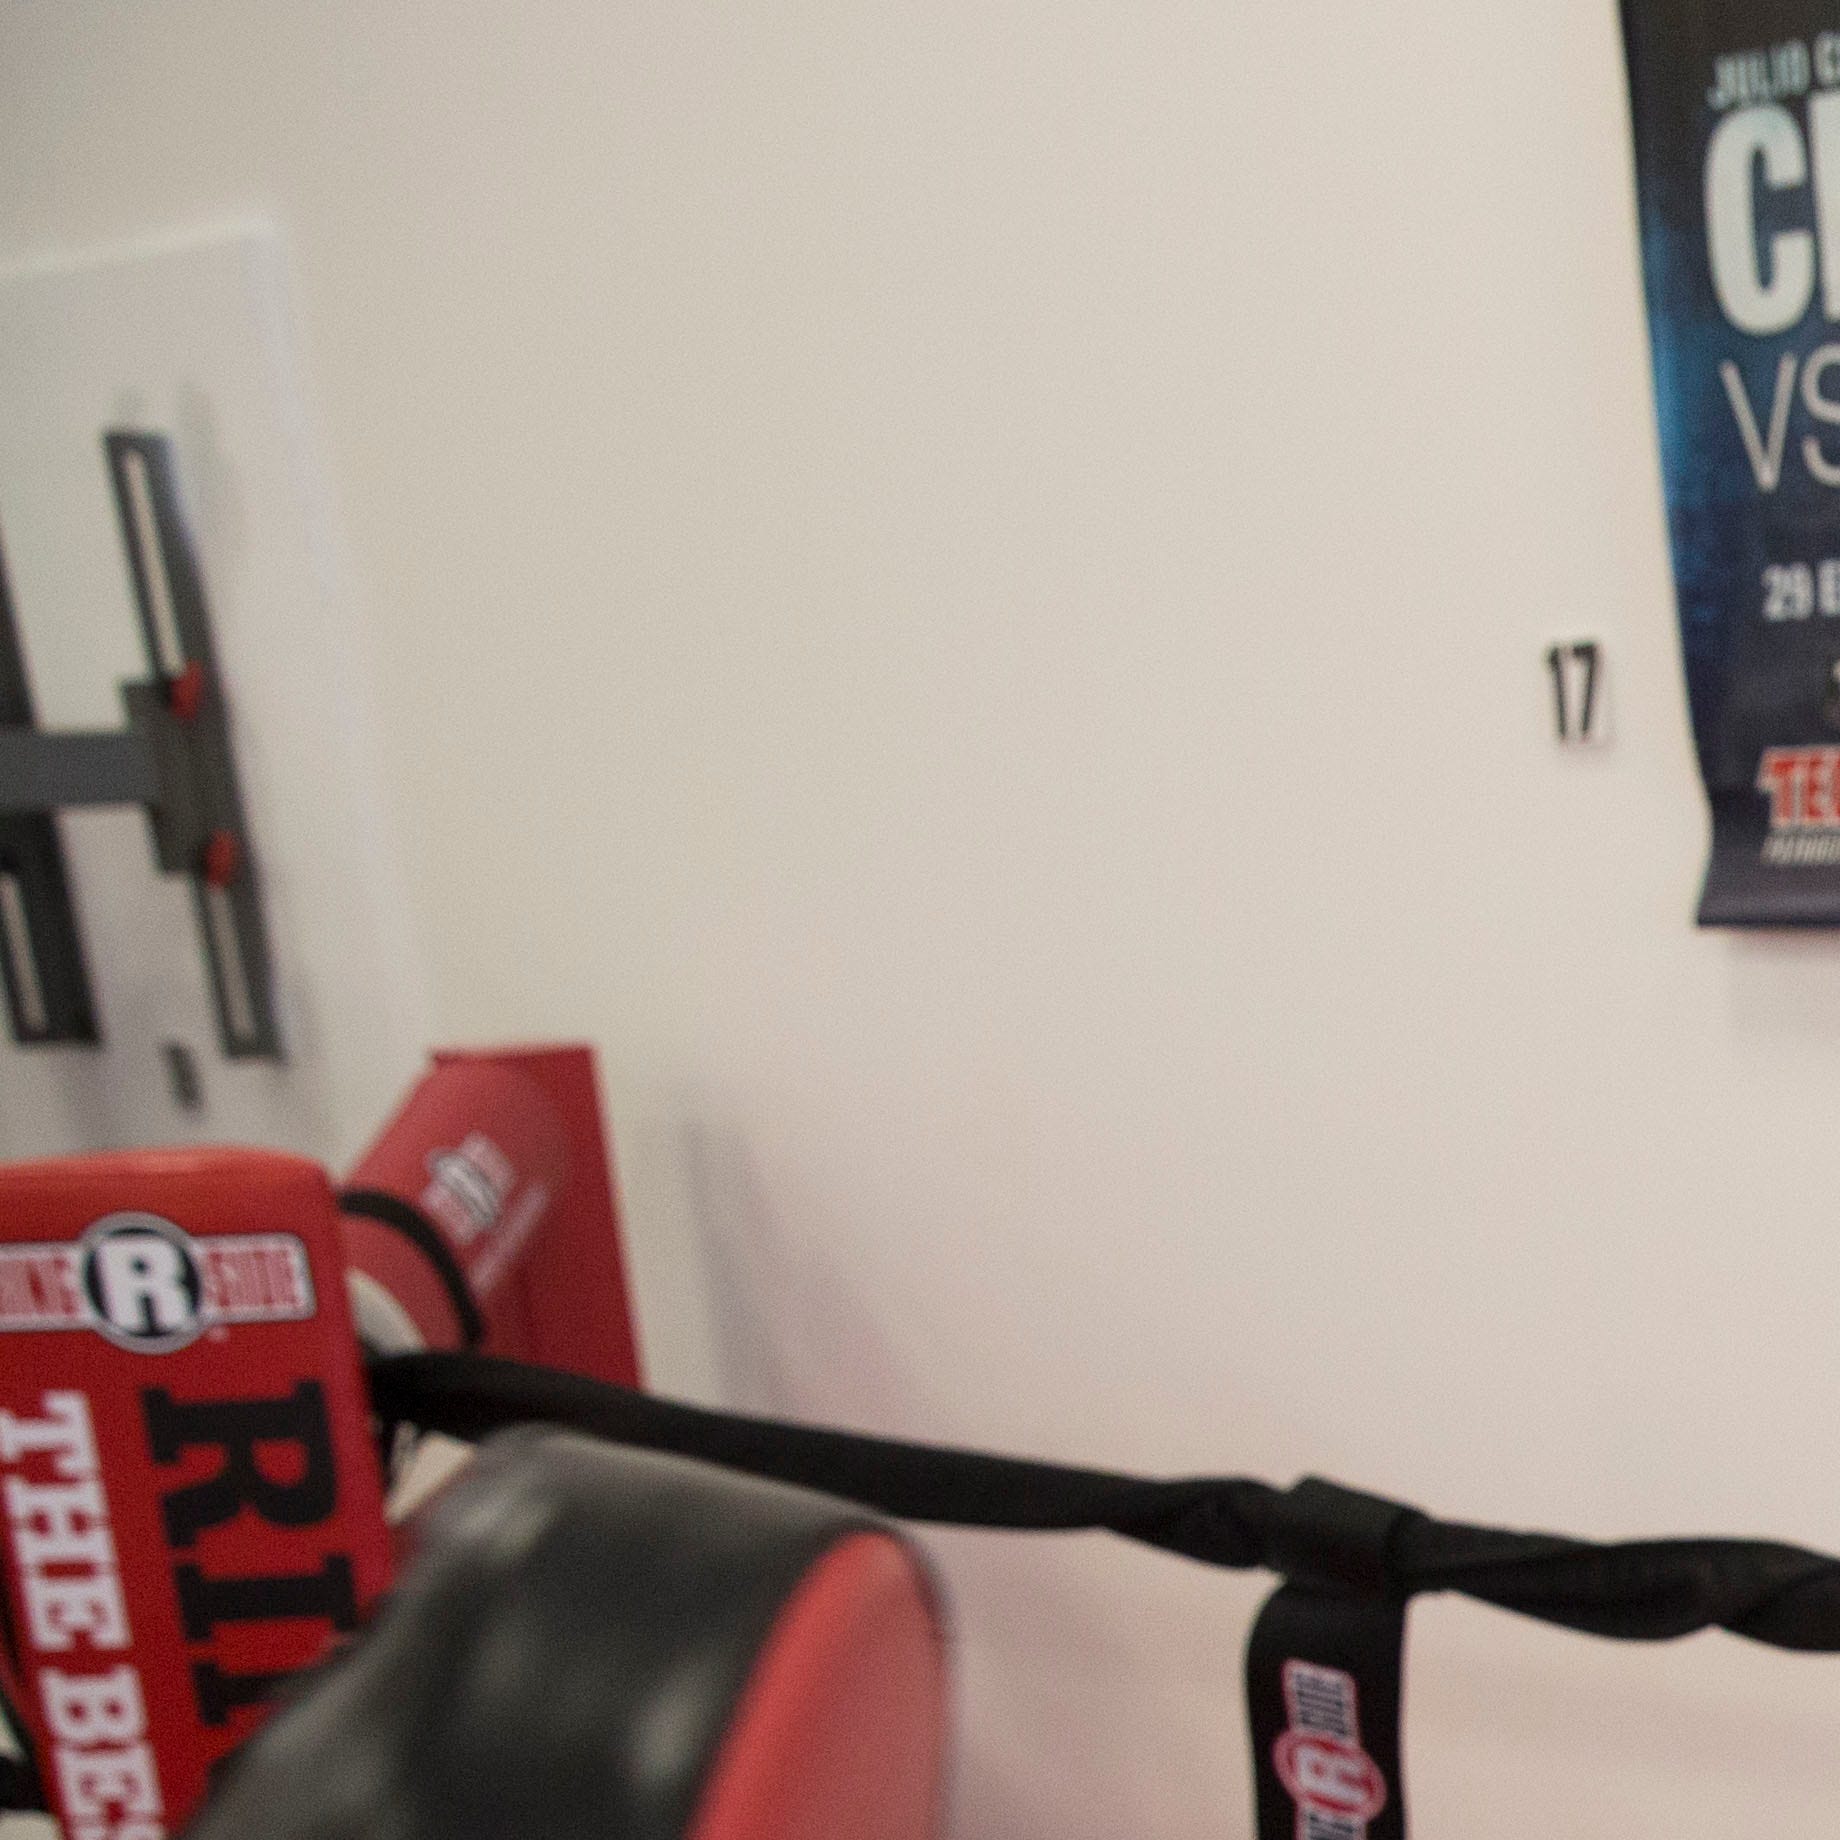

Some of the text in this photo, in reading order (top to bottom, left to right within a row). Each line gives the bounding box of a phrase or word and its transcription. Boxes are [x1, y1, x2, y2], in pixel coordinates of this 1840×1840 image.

[1546, 641, 1600, 740] 17
[98, 1238, 193, 1334] R
[0, 1390, 133, 1652] THE
